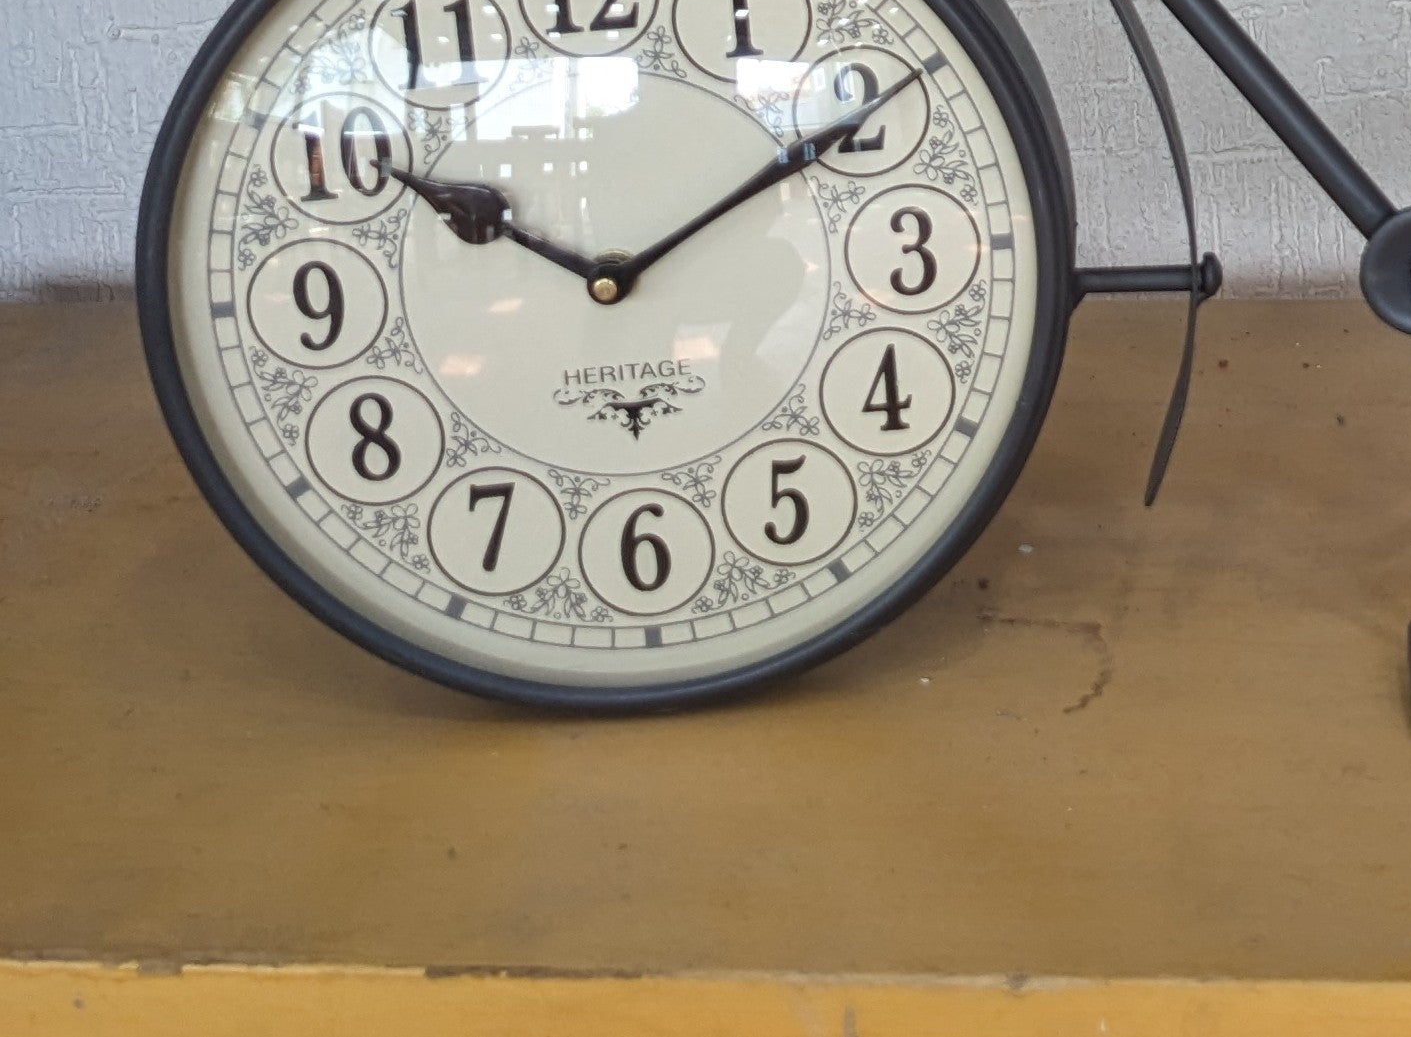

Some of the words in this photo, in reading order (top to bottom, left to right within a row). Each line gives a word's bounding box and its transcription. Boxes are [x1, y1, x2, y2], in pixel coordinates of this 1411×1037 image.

[834, 62, 886, 154] 2
[291, 105, 392, 202] 10
[890, 206, 937, 295] 3
[293, 260, 344, 351] 9
[564, 358, 691, 385] HERITAGE
[862, 344, 912, 431] 4
[350, 393, 401, 481] 8
[469, 482, 515, 572] 7
[764, 455, 809, 545] 5
[621, 503, 671, 591] 6
